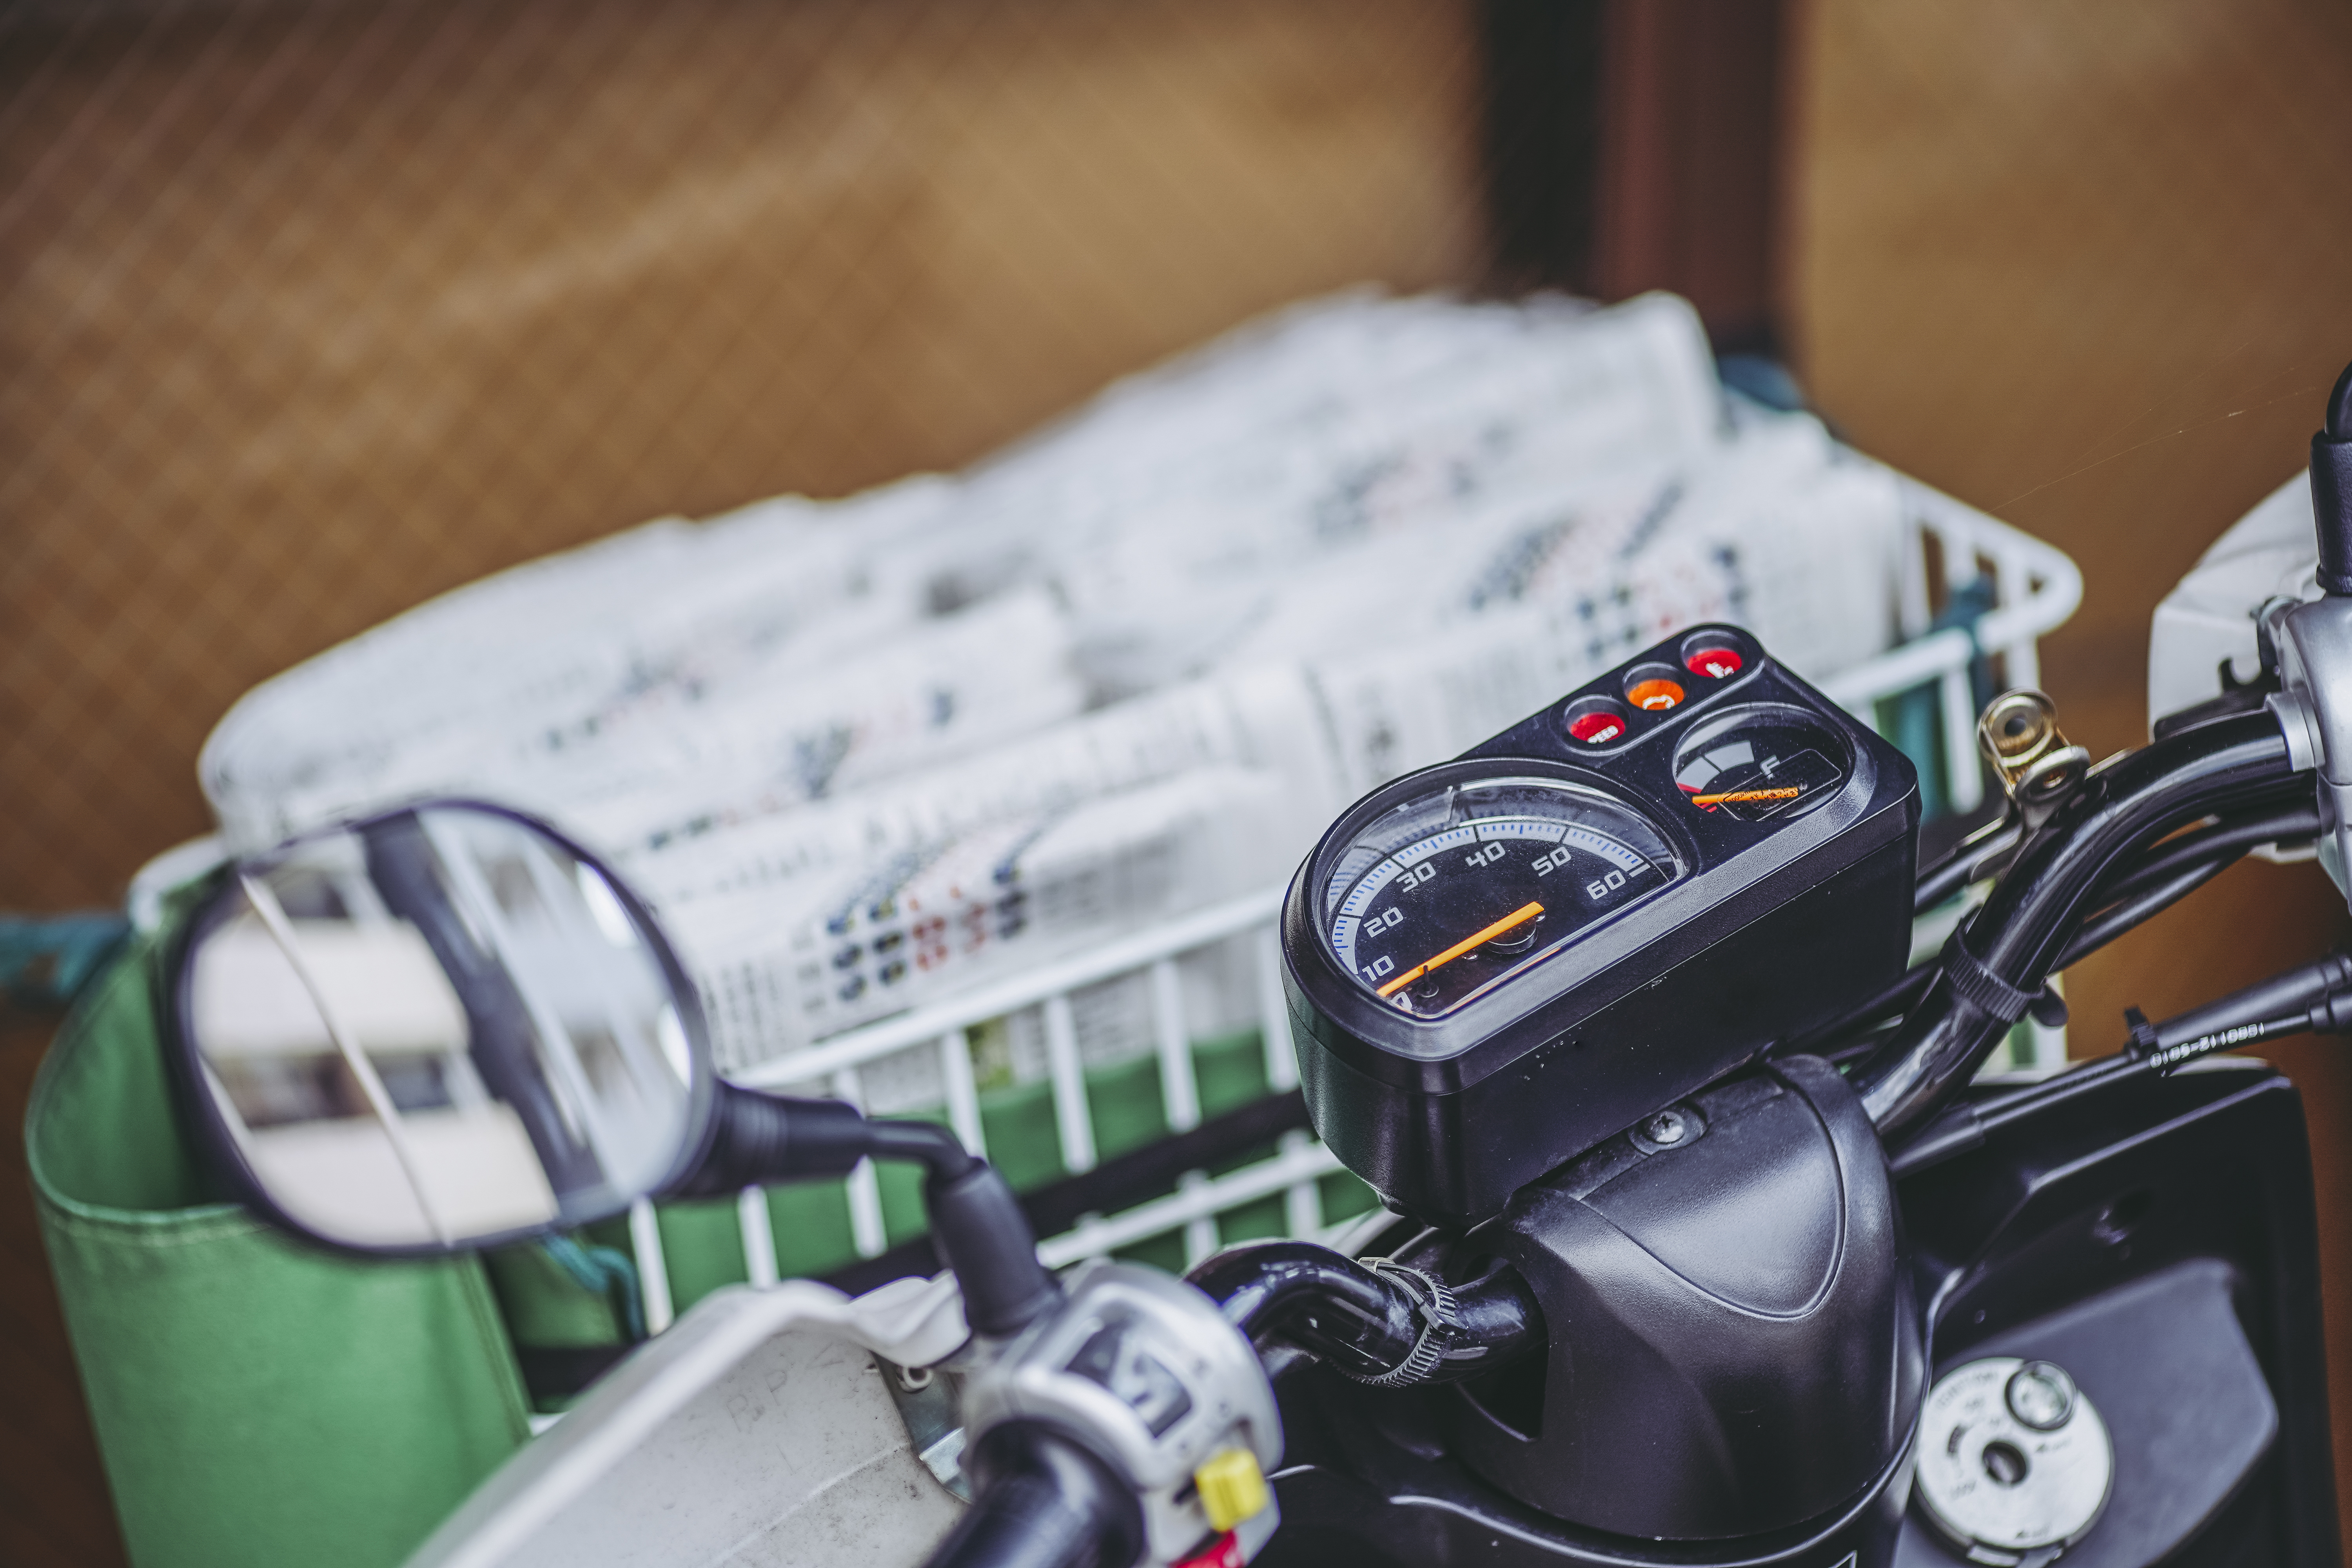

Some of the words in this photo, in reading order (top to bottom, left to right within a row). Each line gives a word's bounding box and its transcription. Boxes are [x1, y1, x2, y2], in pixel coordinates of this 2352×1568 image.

[1760, 755, 1780, 780] F
[1465, 841, 1506, 867] 40
[1531, 845, 1571, 877] 50
[1396, 862, 1436, 893] 30
[1586, 869, 1626, 900] 60
[1363, 906, 1404, 938] 20
[1362, 956, 1395, 982] 10
